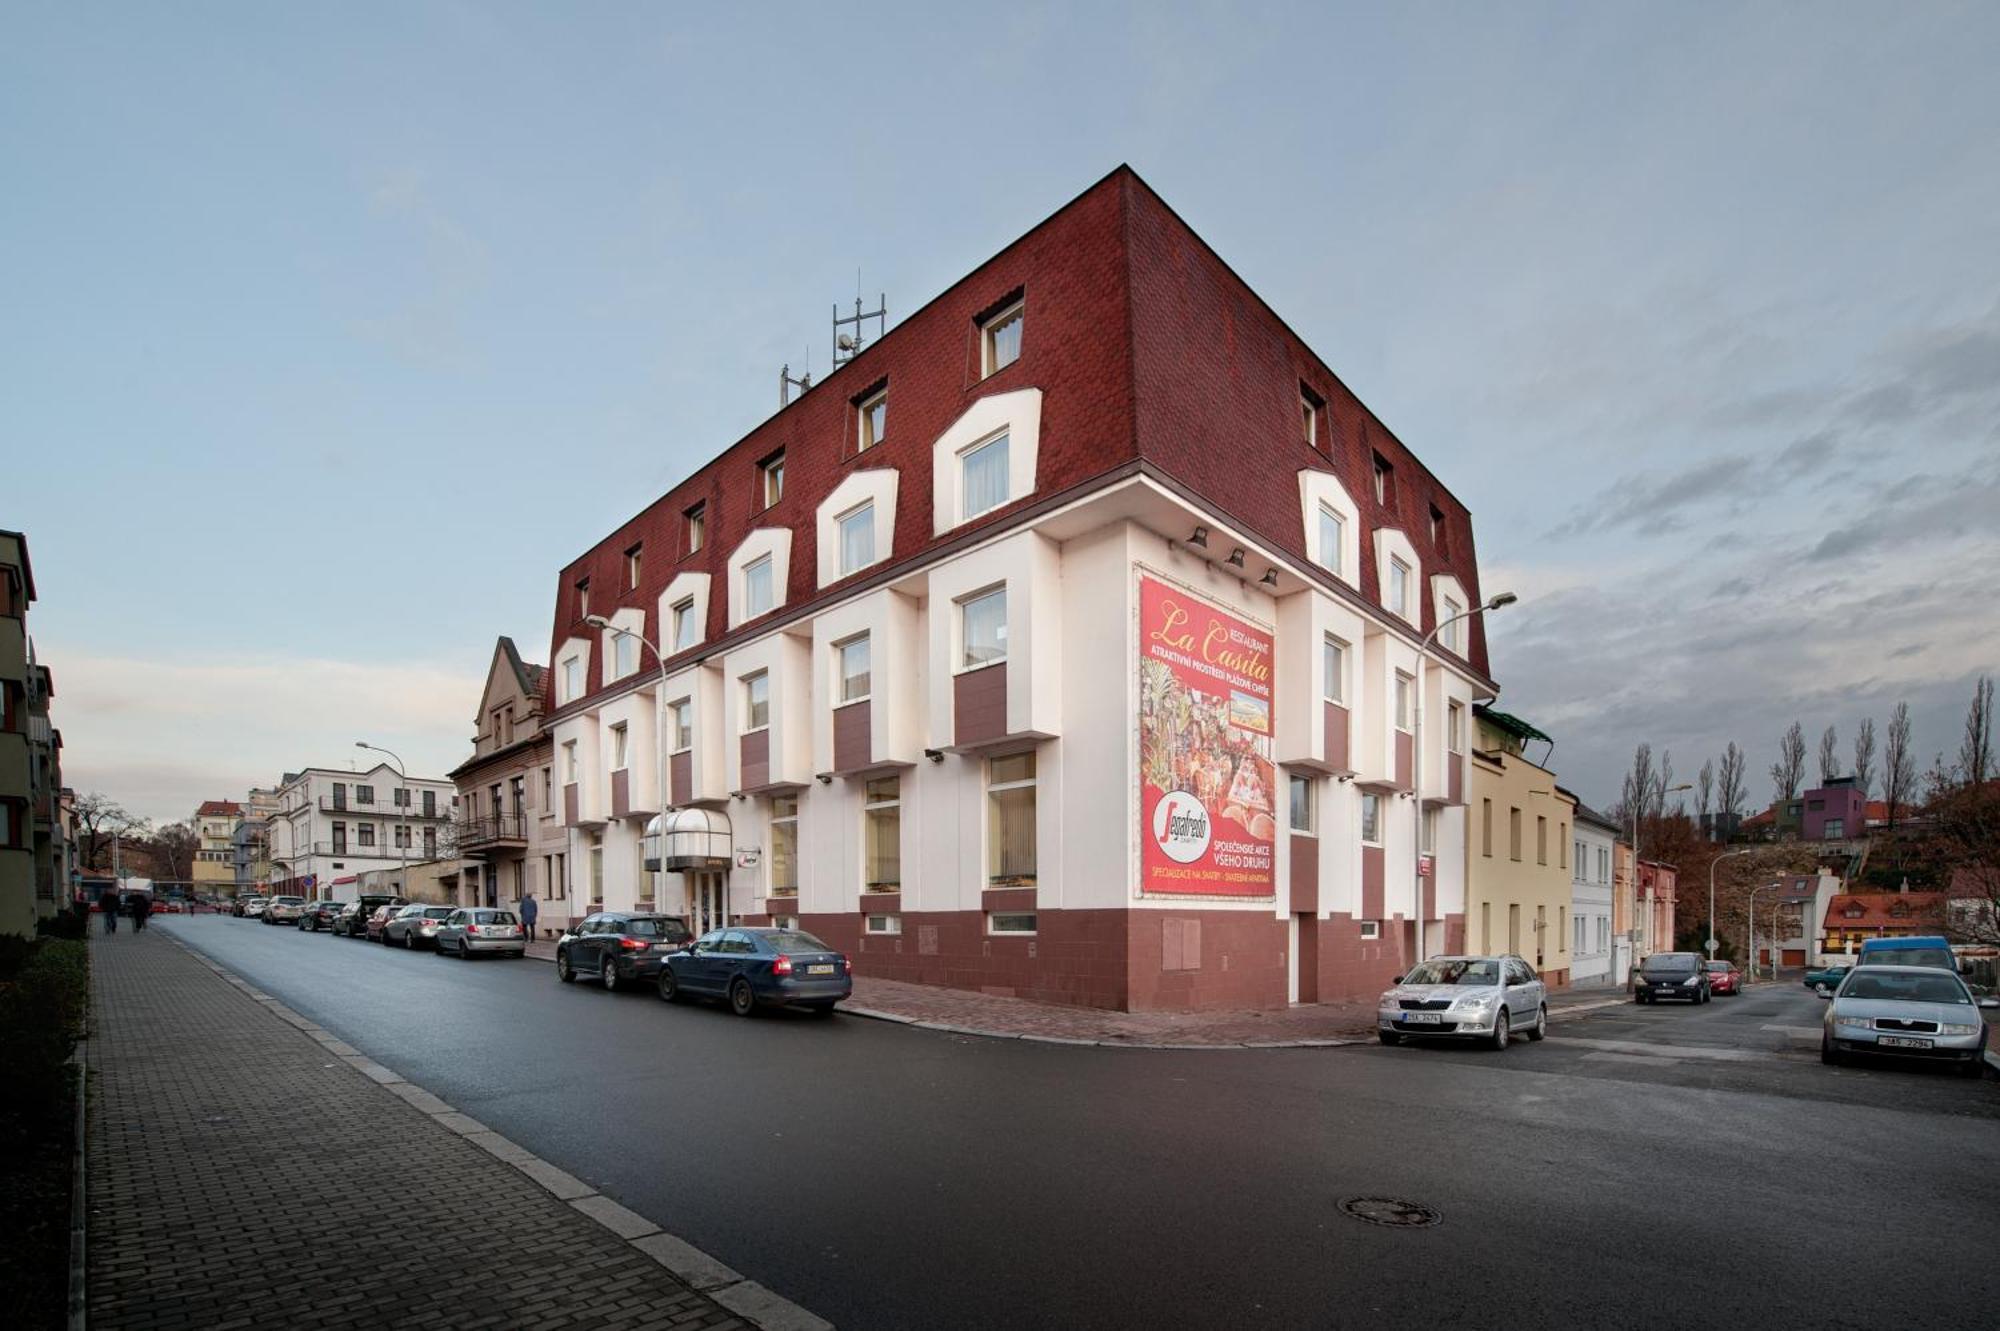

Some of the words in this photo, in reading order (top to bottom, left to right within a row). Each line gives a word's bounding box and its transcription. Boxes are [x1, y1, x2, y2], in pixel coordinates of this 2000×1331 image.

[1150, 599, 1196, 652] La
[1202, 618, 1270, 681] Casita
[1151, 643, 1192, 669] ATRAKTIVNÍ
[1159, 801, 1207, 843] Segafredo
[1213, 839, 1256, 855] SPOLEČENSKÉ
[1213, 851, 1242, 868] VŠEHO
[1242, 855, 1270, 870] DRUHU
